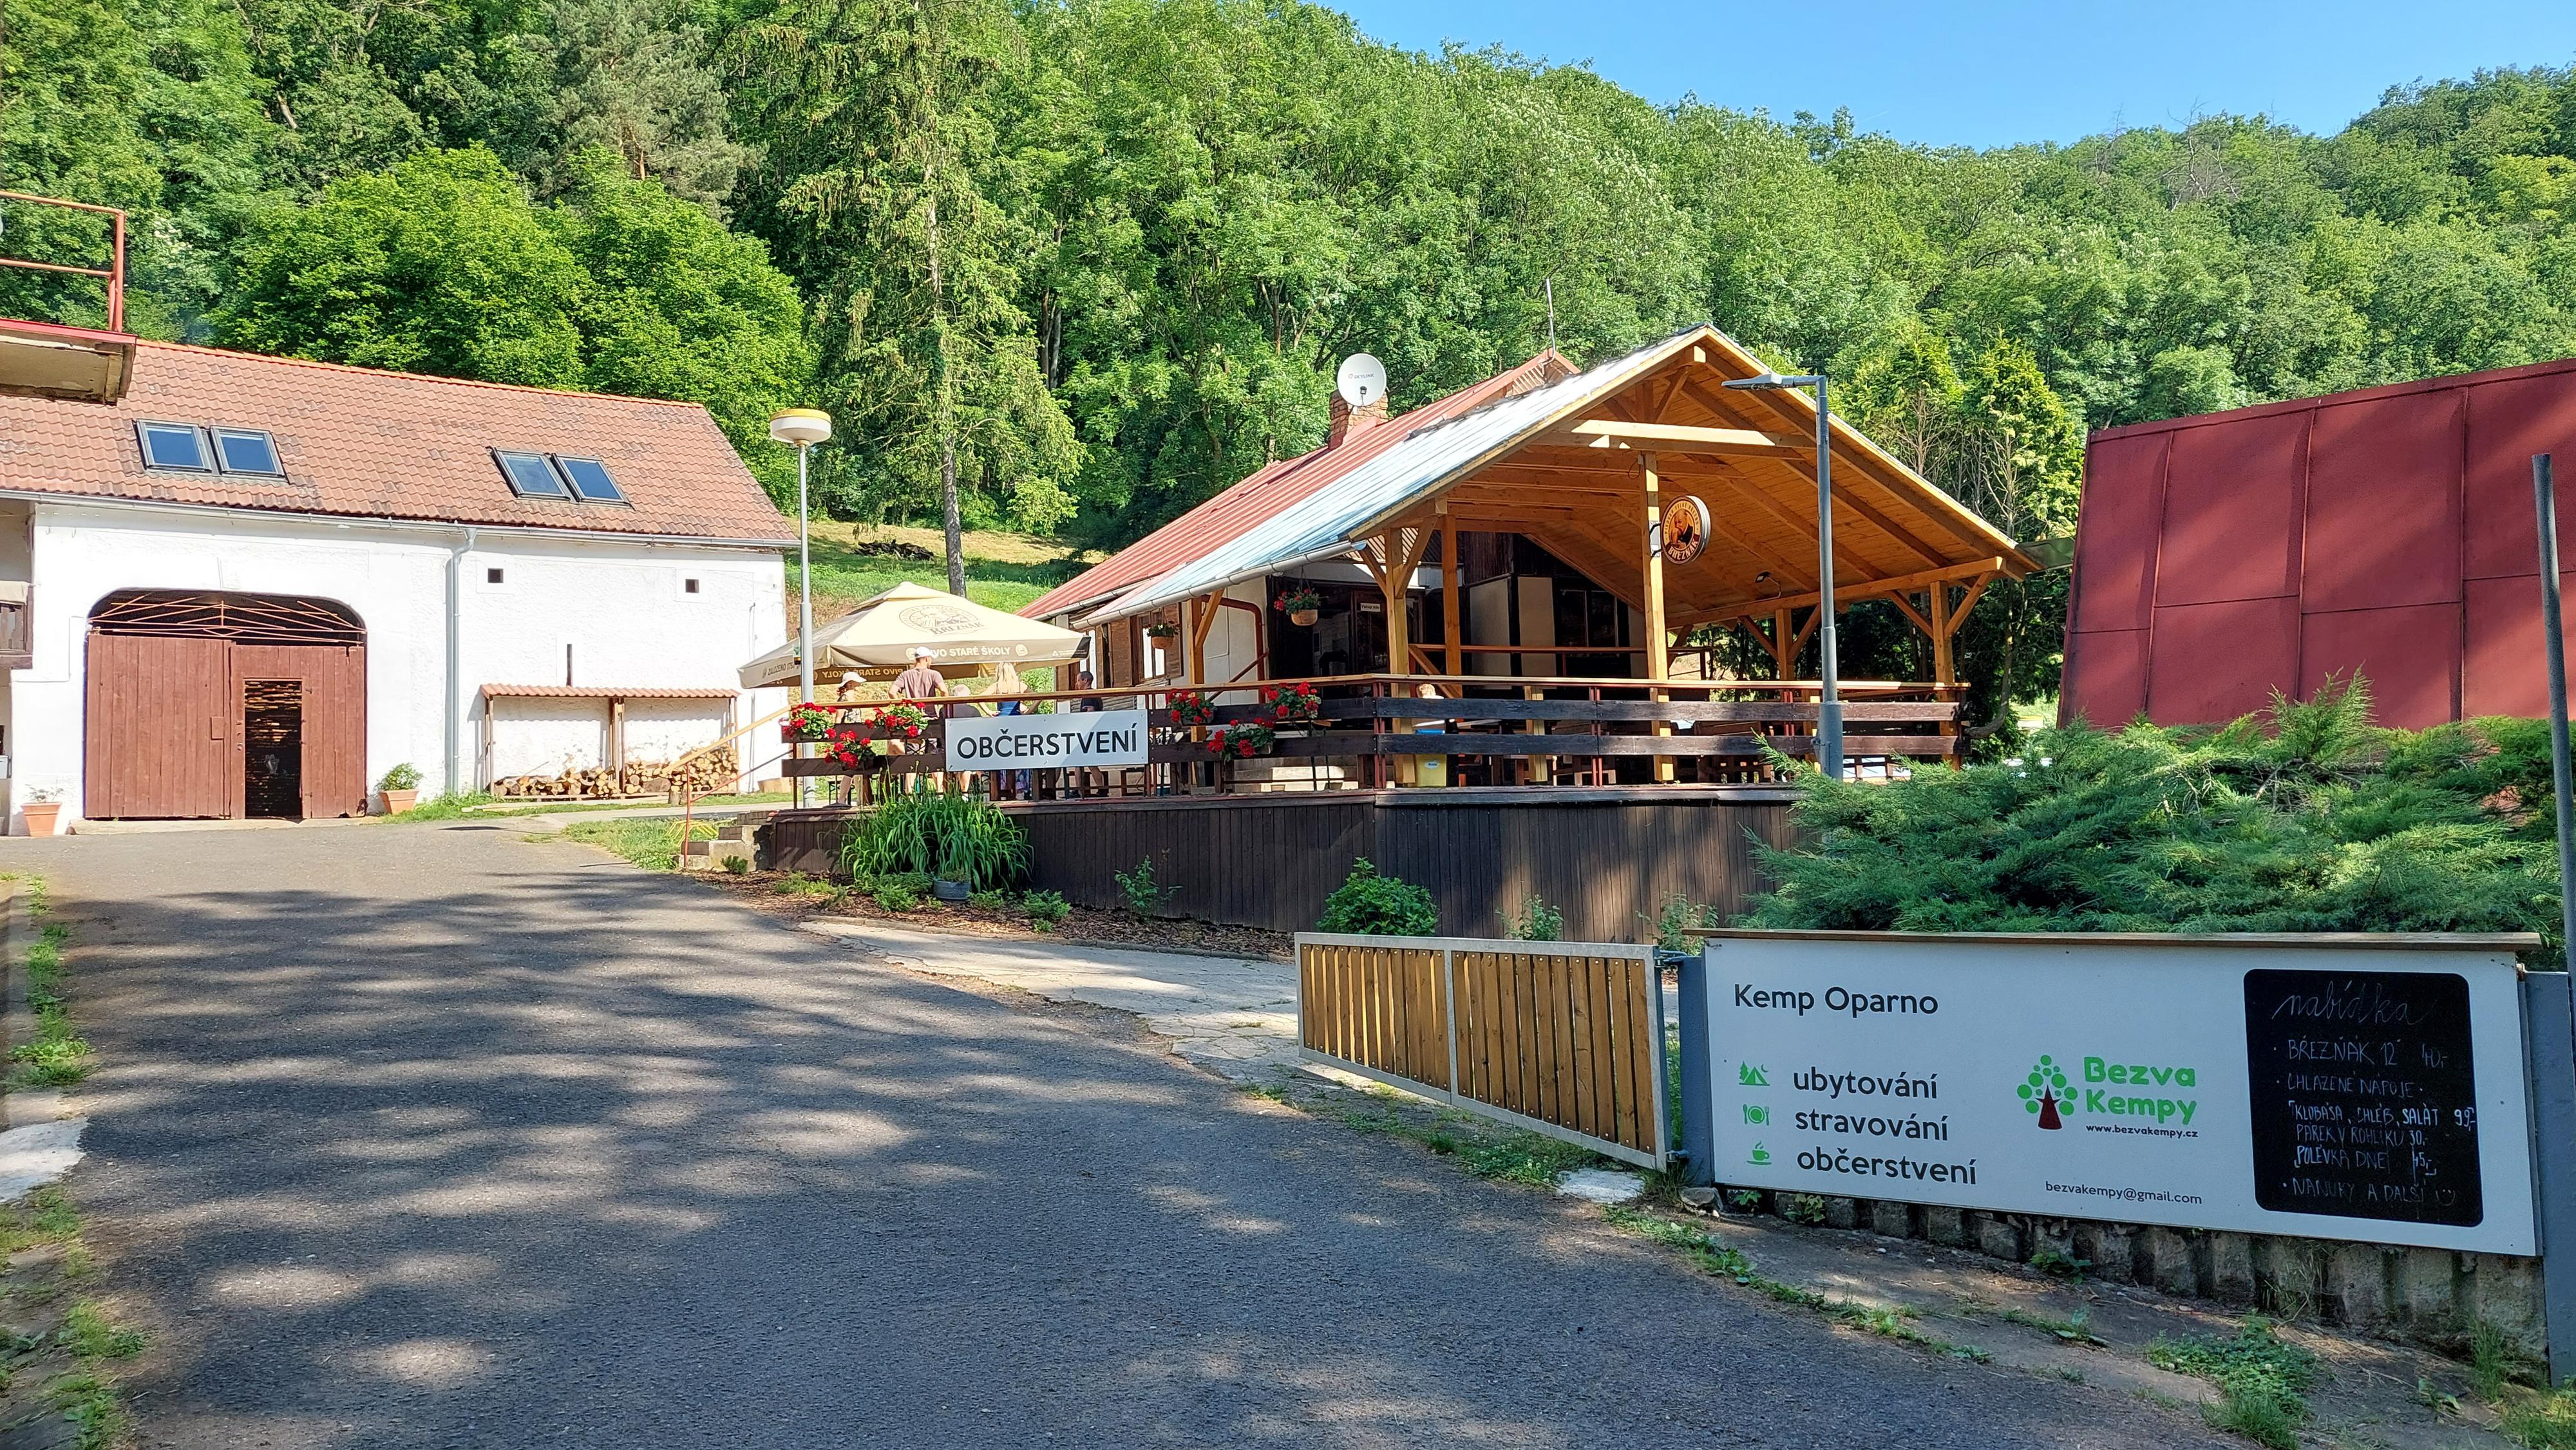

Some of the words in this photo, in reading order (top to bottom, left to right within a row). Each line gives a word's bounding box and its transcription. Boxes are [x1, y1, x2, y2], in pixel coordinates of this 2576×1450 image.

[949, 645, 981, 657] STARÉ
[981, 644, 1011, 656] ŠKOLY
[957, 723, 1137, 759] OBČERSTVENÍ
[1734, 984, 1815, 1016] Kemp
[1824, 986, 1938, 1019] Oparno
[2271, 980, 2424, 1026] nabídka
[1794, 1066, 1938, 1099] ubytování
[2083, 1057, 2195, 1087] Bezva
[2287, 1070, 2354, 1093] CHLAZENÉ
[2086, 1089, 2197, 1125] Kempy
[1795, 1108, 1948, 1141] stravování
[2086, 1124, 2199, 1139] www.bezvakempy.cz
[1797, 1145, 1976, 1185] občerstvení
[2045, 1181, 2202, 1205] bezvakempy@gmail.com
[2368, 1183, 2378, 1201] A
